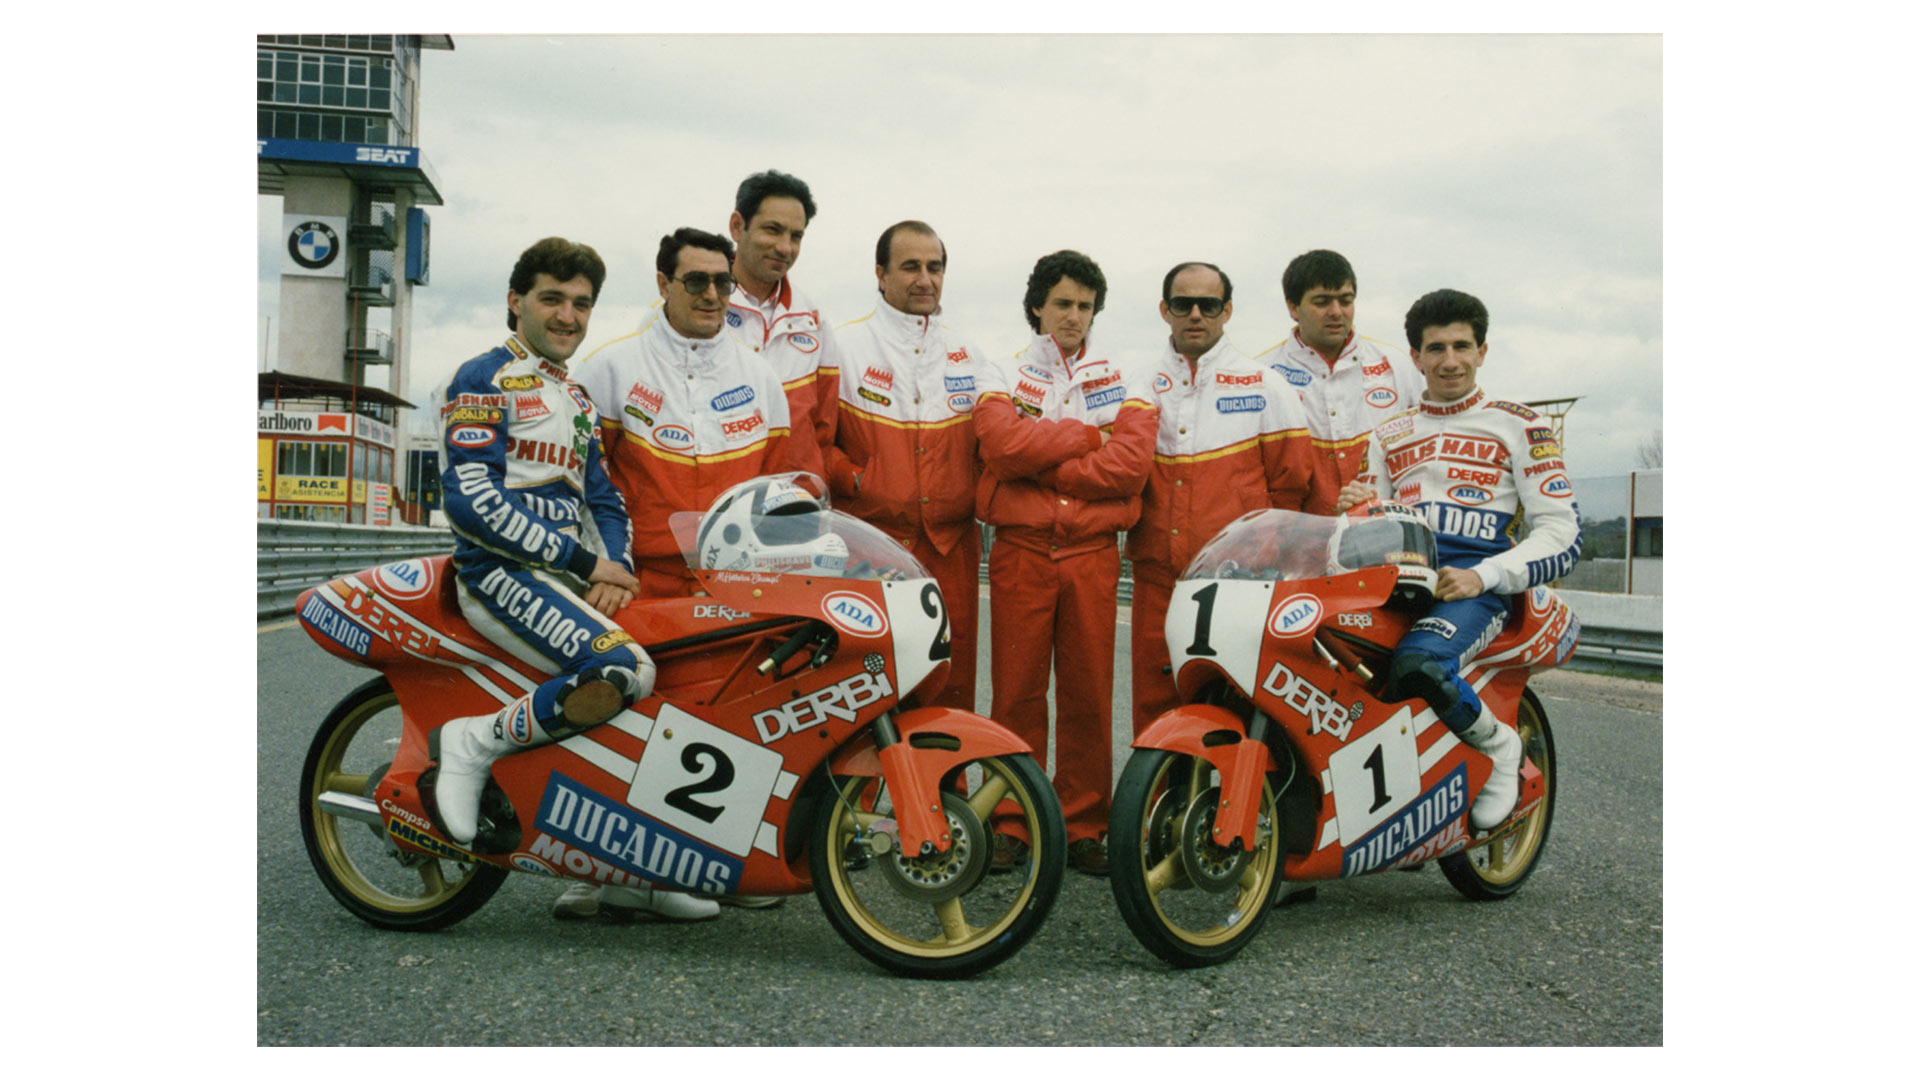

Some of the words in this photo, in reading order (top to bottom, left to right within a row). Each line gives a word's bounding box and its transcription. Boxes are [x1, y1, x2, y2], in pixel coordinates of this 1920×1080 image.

[355, 147, 411, 164] SEAT
[295, 222, 335, 239] BMW
[793, 335, 814, 346] ADA
[1026, 365, 1051, 380] ADA
[1371, 390, 1392, 400] ADA
[456, 431, 490, 441] ADA
[659, 428, 690, 443] ADA
[298, 479, 339, 489] RACE
[1455, 488, 1486, 501] ADA
[454, 462, 563, 562] DUCADOS
[302, 595, 371, 657] DUCADOS
[478, 566, 592, 659] DUCADOS
[832, 600, 875, 628] ADA
[919, 582, 951, 662] 2
[1185, 581, 1219, 657] 1
[1282, 602, 1315, 630] ADA
[663, 741, 736, 824] 2
[1363, 743, 1392, 814] 1
[381, 798, 431, 831] Campsa
[1346, 773, 1464, 878] DUCADOS
[545, 783, 731, 895] DUCADOS
